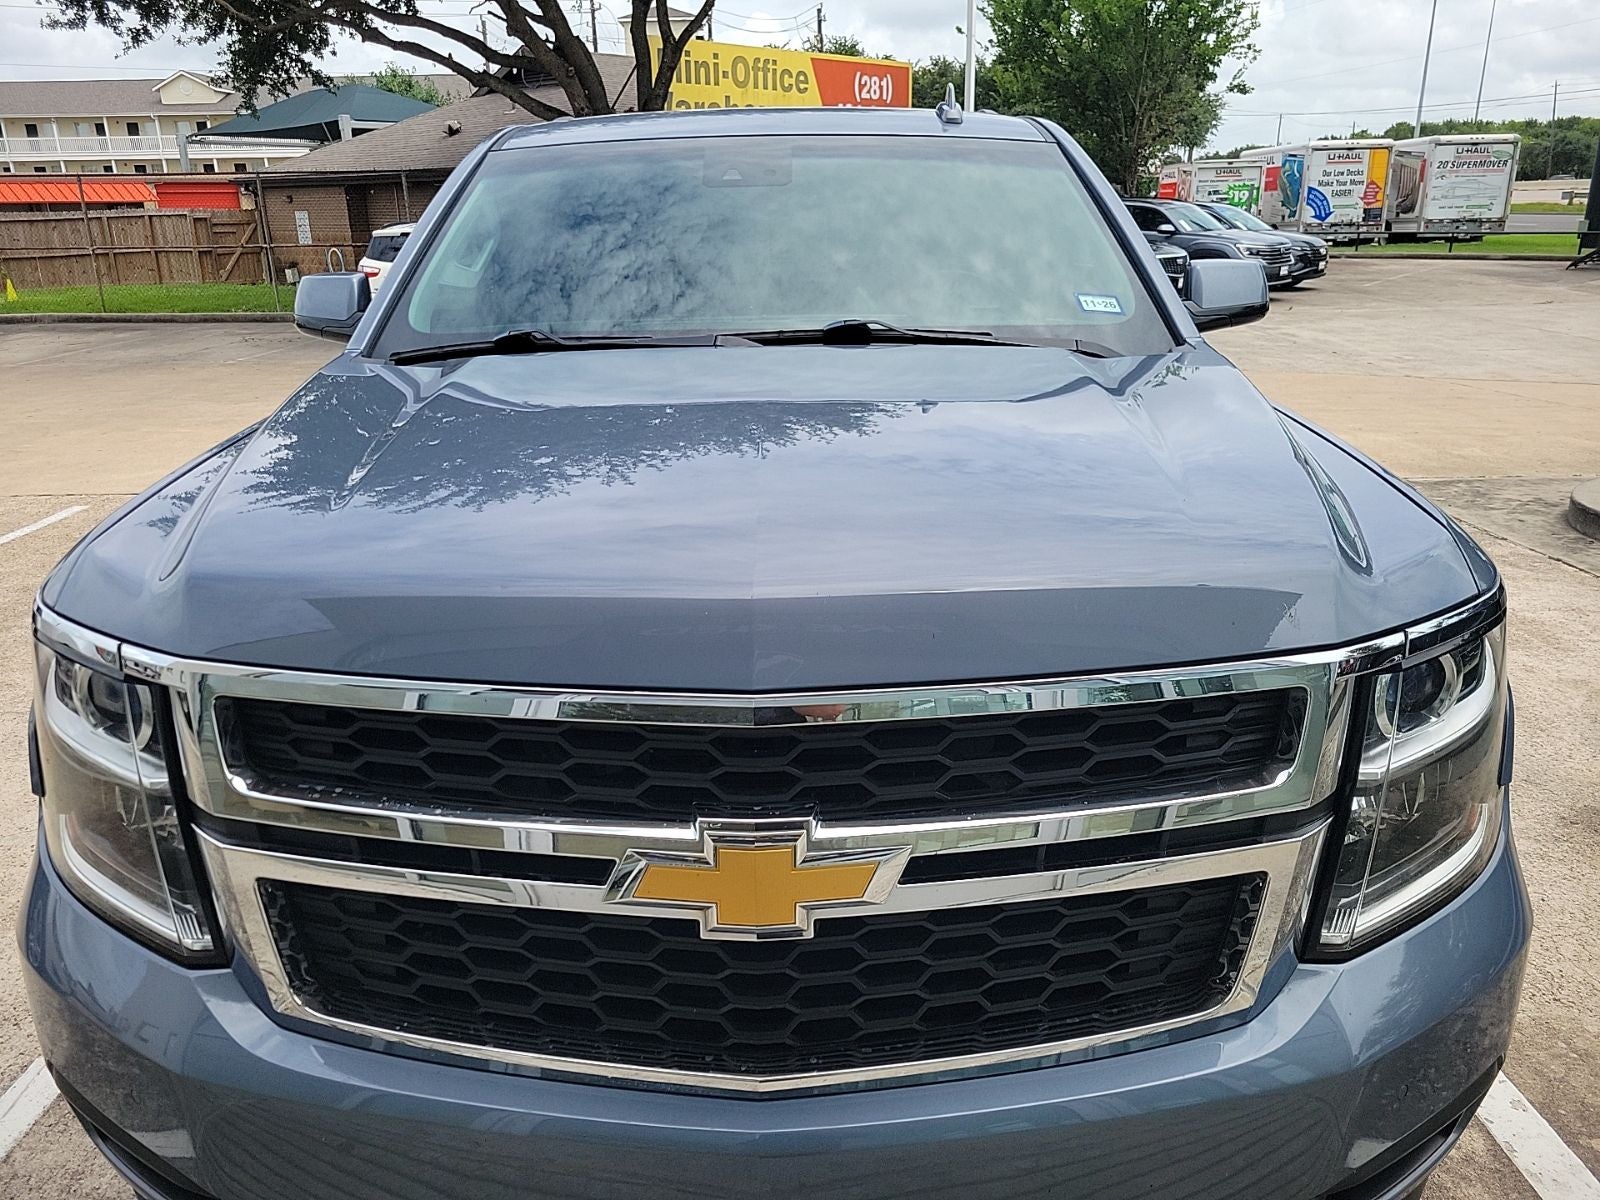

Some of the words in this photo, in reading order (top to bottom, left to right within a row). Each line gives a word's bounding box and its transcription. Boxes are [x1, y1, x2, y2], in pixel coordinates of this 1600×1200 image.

[854, 71, 893, 103] (281)
[1456, 146, 1491, 154] U-HAUL
[1450, 159, 1509, 169] SUPERMOVER
[1346, 168, 1364, 176] Decks
[1317, 179, 1334, 187] Make
